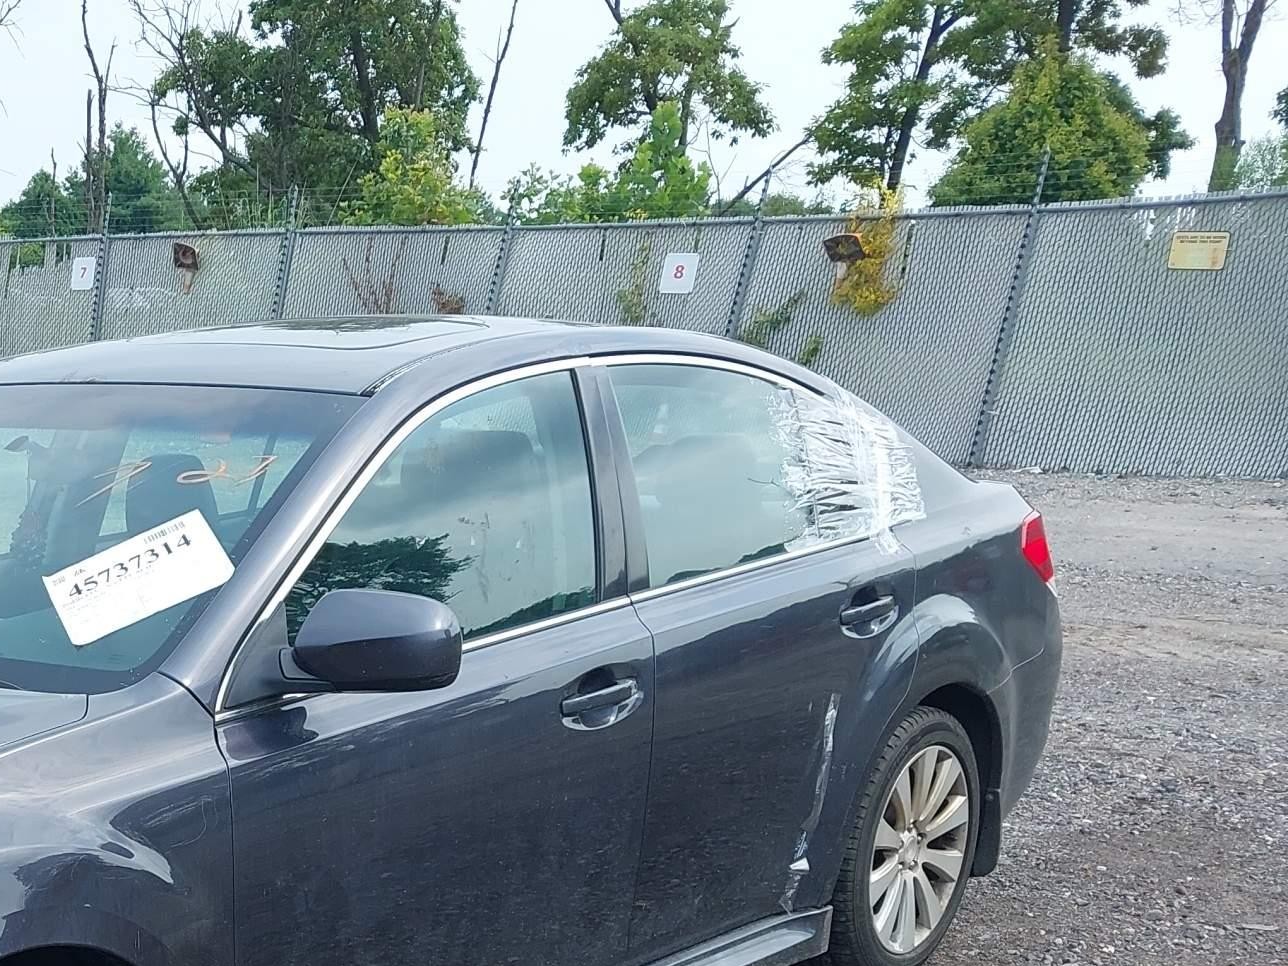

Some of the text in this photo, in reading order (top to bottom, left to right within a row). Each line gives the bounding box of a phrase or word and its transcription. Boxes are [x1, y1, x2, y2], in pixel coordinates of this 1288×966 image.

[80, 266, 88, 279] 7
[673, 264, 685, 279] 8
[68, 533, 192, 599] 45737314
